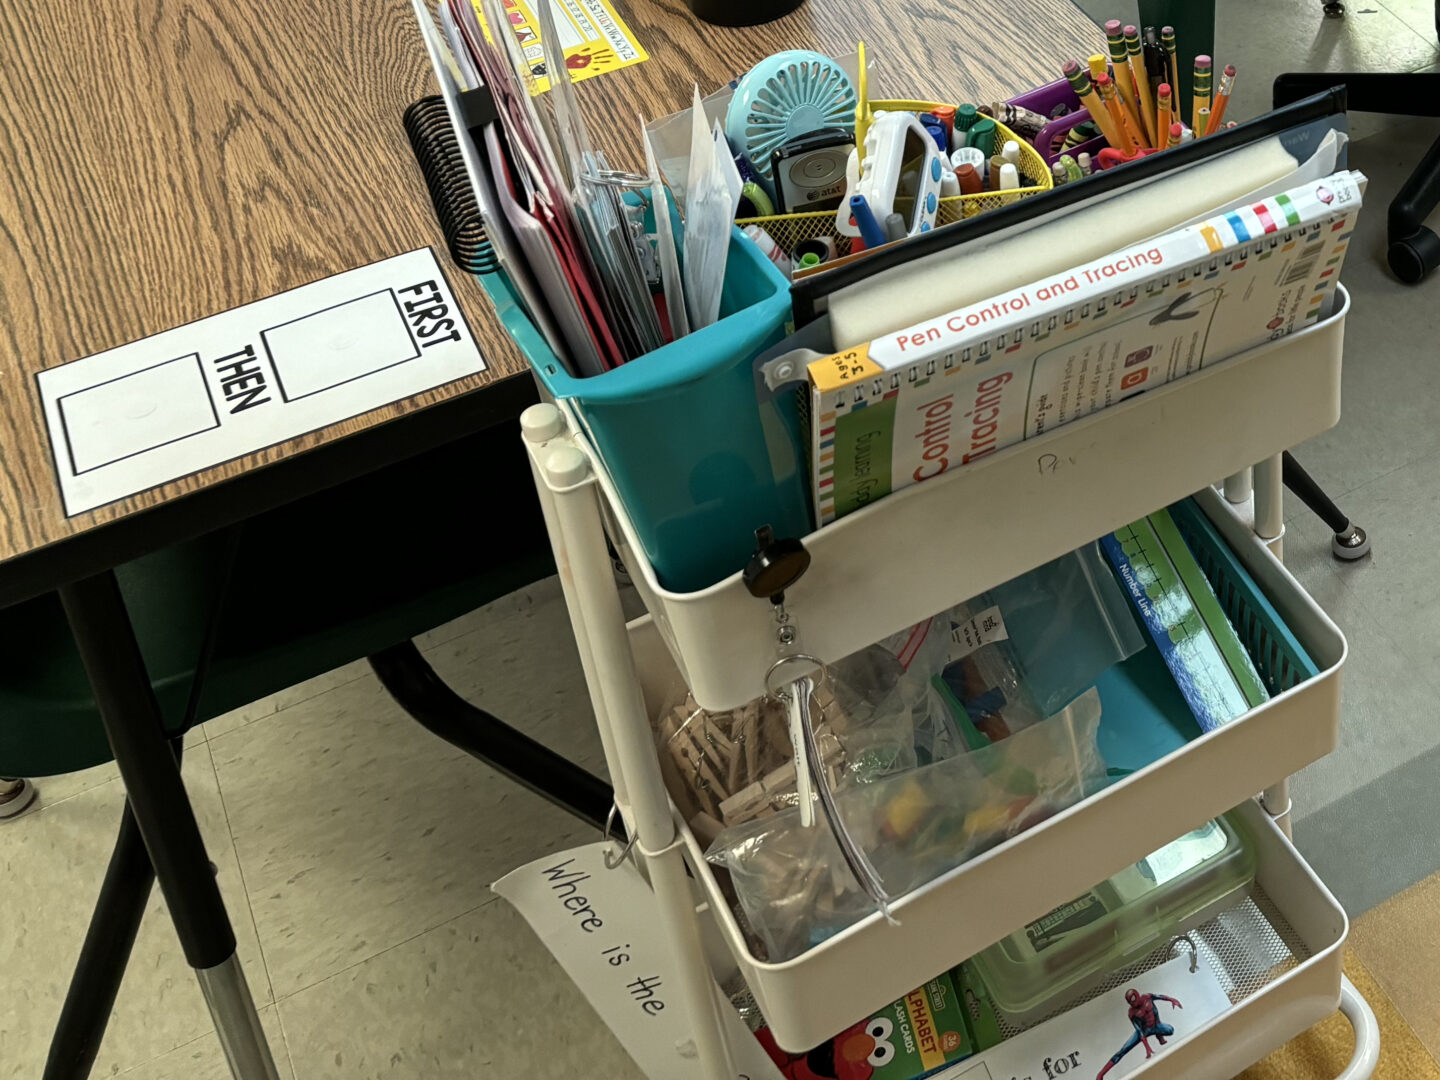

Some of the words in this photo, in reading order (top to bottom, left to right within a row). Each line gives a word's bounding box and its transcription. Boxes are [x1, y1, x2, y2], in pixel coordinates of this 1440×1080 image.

[820, 186, 842, 198] at&t
[398, 279, 461, 348] FIRST
[896, 327, 942, 352] Pen
[946, 292, 1031, 333] Control
[1036, 276, 1080, 301] and
[1081, 247, 1164, 285] Tracing
[213, 344, 271, 414] THEN
[831, 356, 848, 380] Ages
[844, 352, 864, 376] 3-5
[913, 393, 954, 483] Control
[962, 372, 1014, 465] Tracing
[1119, 564, 1142, 599] Number
[1137, 598, 1152, 618] Line
[542, 858, 603, 933] Where
[601, 944, 630, 966] is
[626, 975, 665, 1016] the
[901, 1024, 916, 1054] CARDS
[904, 986, 937, 1053] LPHABET
[948, 1035, 957, 1047] 36
[1042, 1050, 1081, 1080] for
